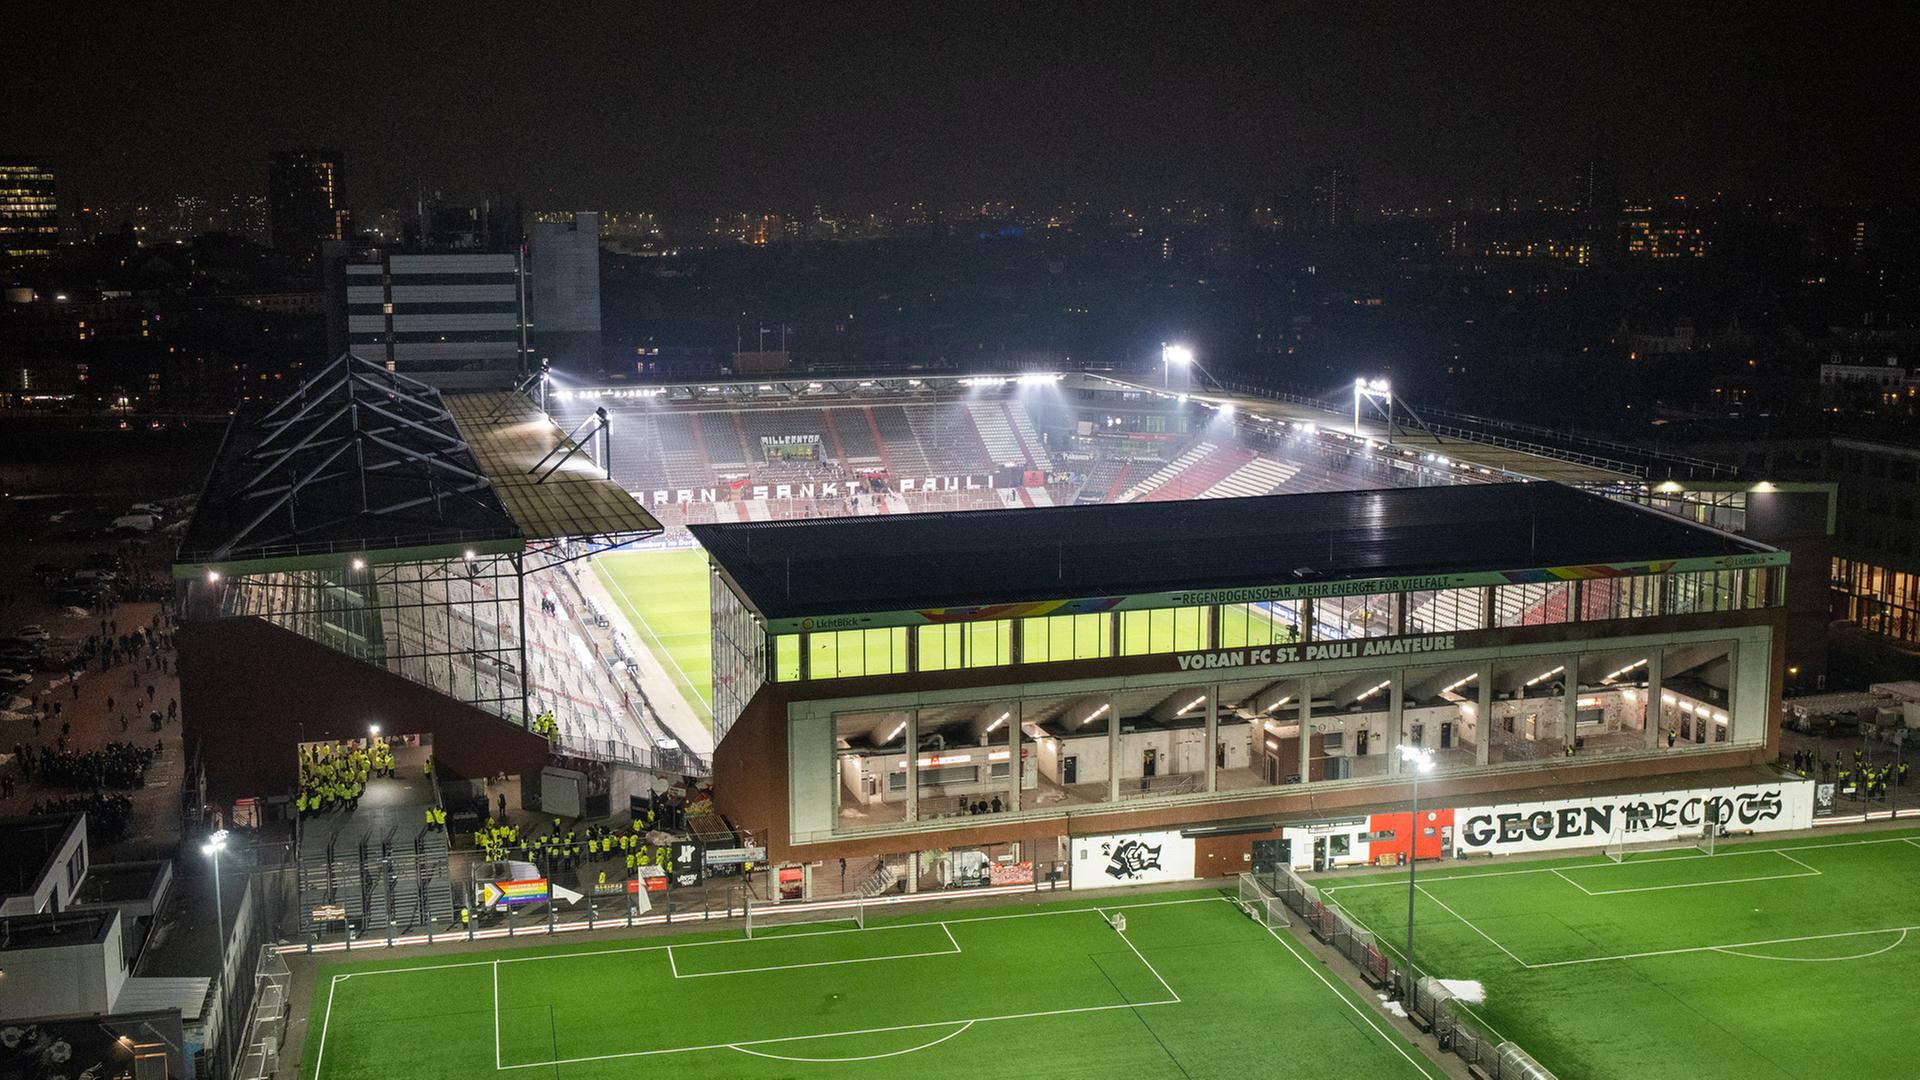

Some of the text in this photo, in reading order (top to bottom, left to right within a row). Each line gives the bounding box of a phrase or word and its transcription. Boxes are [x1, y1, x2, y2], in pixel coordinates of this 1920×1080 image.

[761, 435, 820, 445] MILLERNTOR
[752, 481, 860, 500] SANKT
[900, 475, 994, 493] PAULI
[1182, 576, 1451, 605] REGENBOGENSOLAR. MEHR ENERGIE FÜR VIELFALT.
[816, 617, 859, 629] LichtBlick
[1177, 635, 1455, 671] VORAN FC ST. PAULI AMATEURE
[1462, 789, 1783, 847] GEGEN RECHTS
